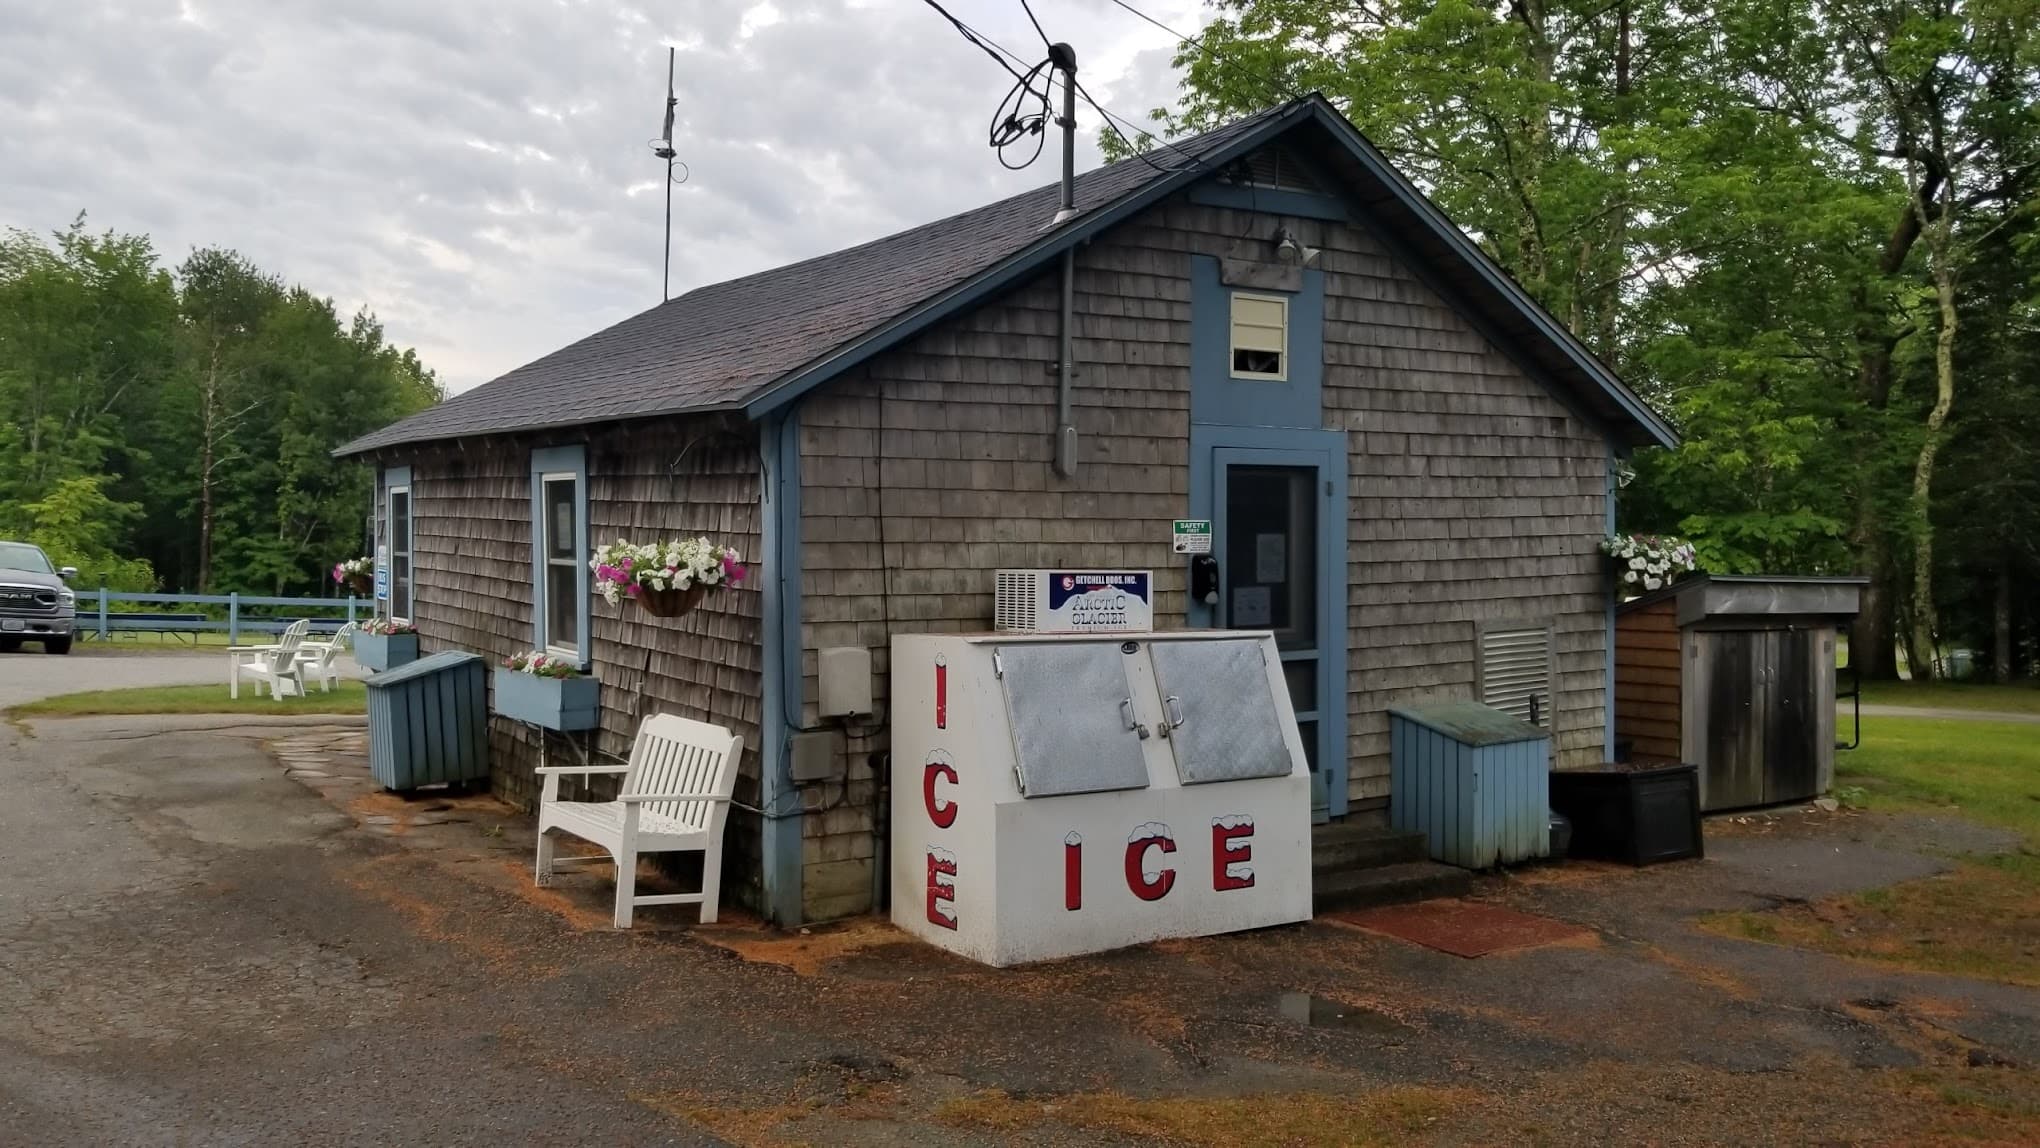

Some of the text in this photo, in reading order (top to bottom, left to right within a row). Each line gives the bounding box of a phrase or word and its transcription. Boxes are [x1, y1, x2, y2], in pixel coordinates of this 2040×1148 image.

[1075, 575, 1105, 585] GETCHELL
[1072, 595, 1126, 611] ARCTIC
[1072, 612, 1127, 625] GLACIER
[923, 652, 959, 931] ICE
[1064, 814, 1255, 911] ICE
